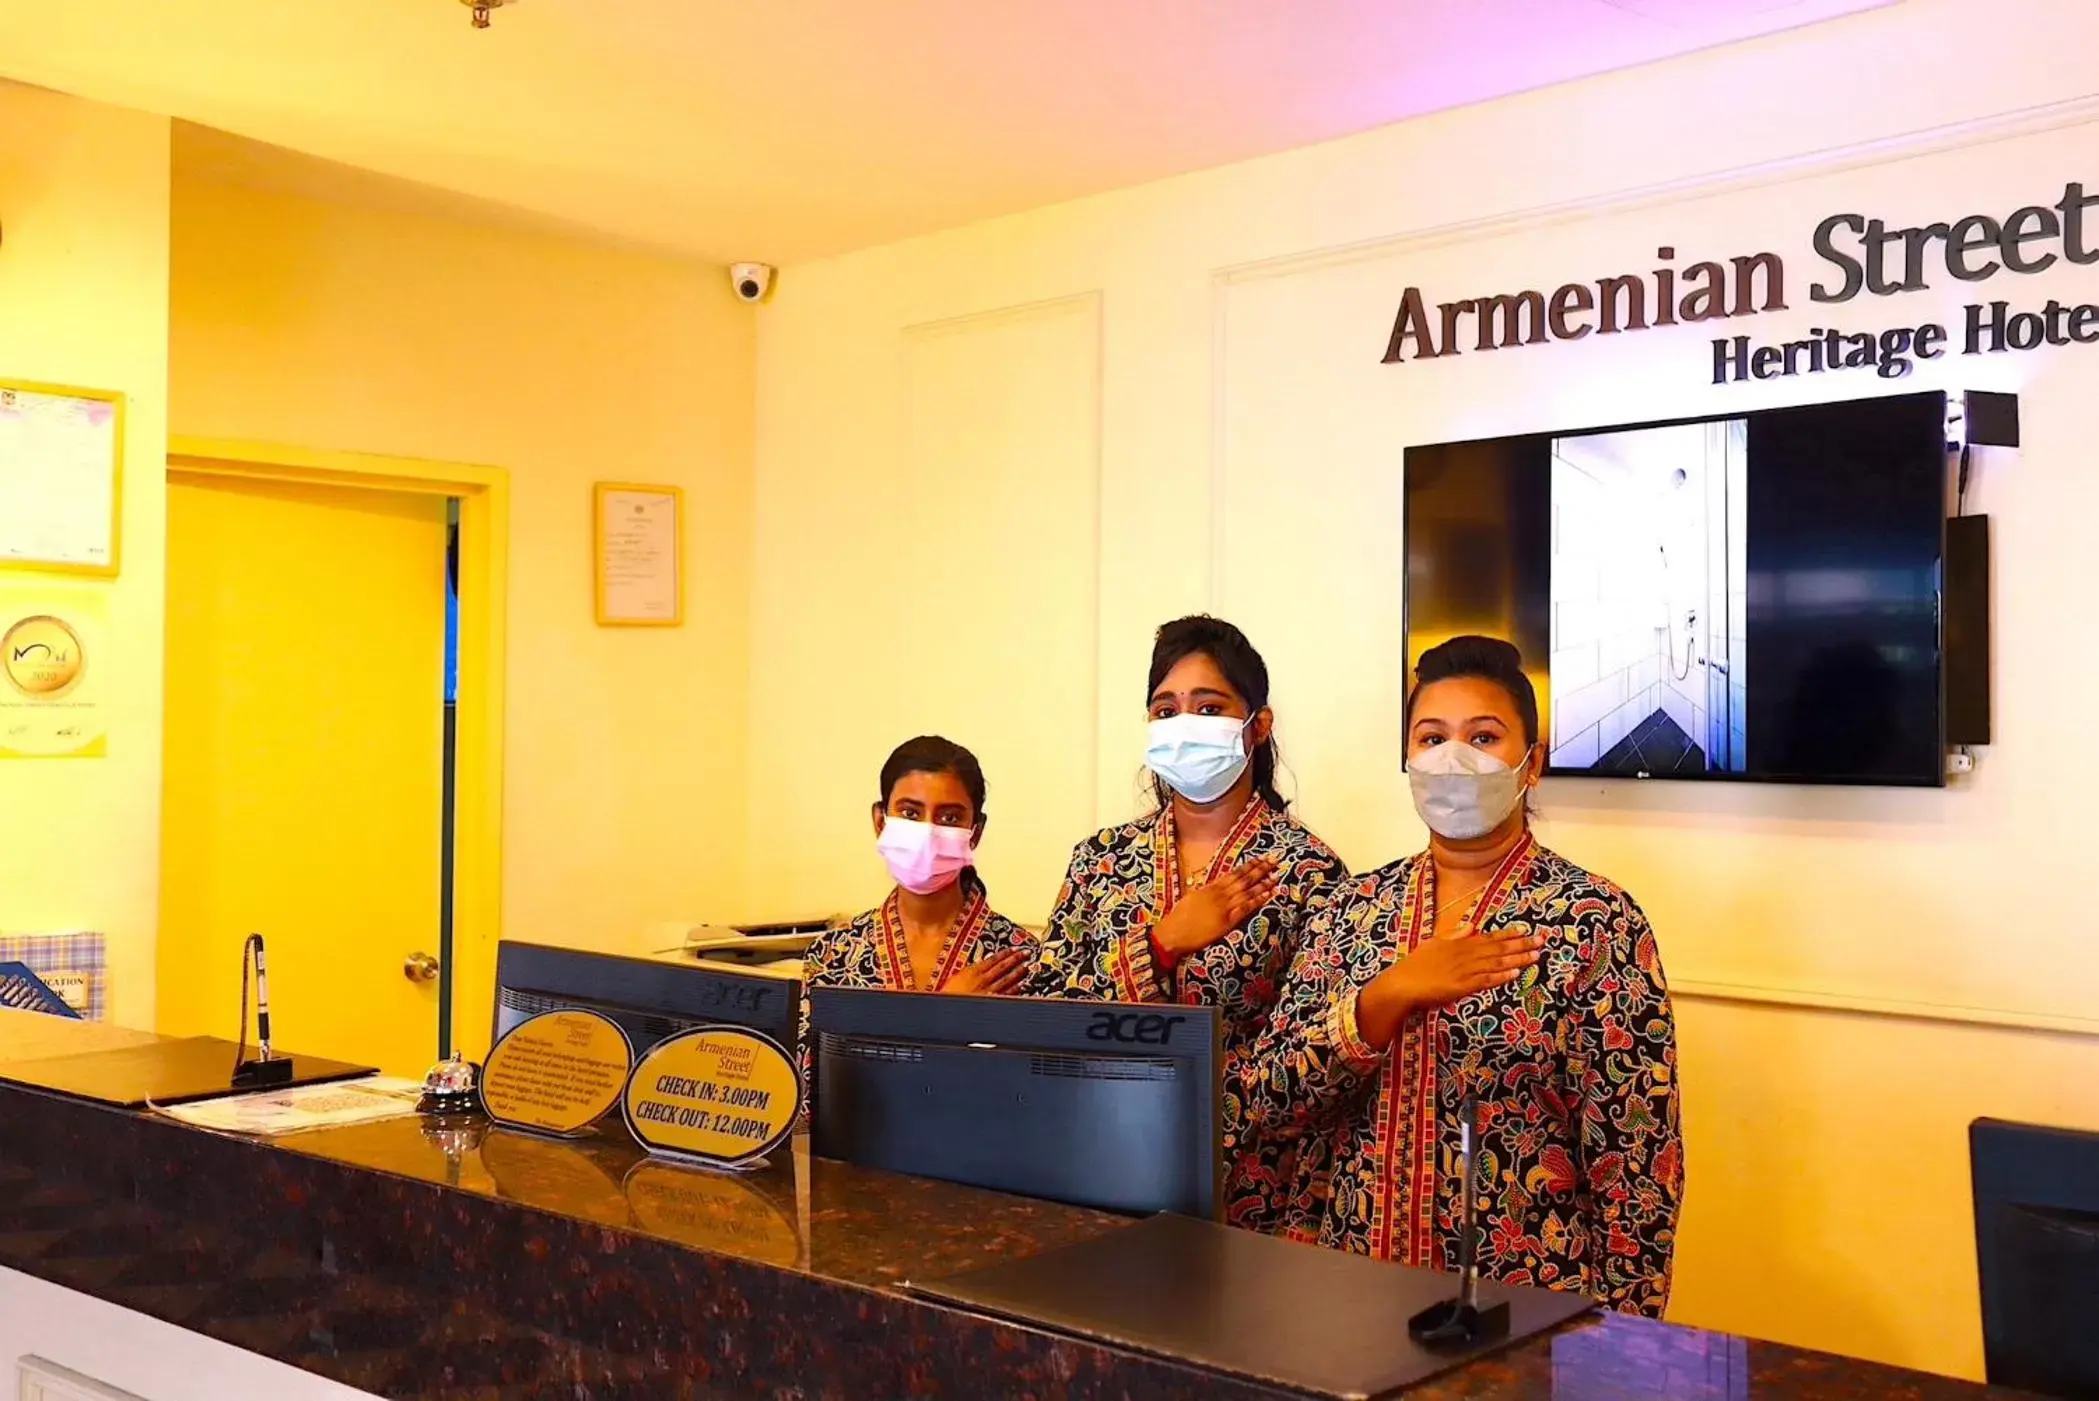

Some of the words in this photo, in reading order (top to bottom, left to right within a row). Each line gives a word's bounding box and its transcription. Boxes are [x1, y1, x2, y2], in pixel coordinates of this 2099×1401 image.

[1381, 246, 1789, 363] Armenian
[1810, 182, 2099, 302] Street
[1711, 323, 1947, 384] Heritage
[1086, 1011, 1185, 1045] acer
[695, 1037, 752, 1059] Armenian
[717, 1056, 751, 1073] Street
[656, 1074, 700, 1098] CHECK
[700, 1080, 719, 1101] IN:
[719, 1086, 771, 1110] 3.00PM
[636, 1100, 679, 1124] CHECK
[679, 1108, 710, 1130] OUT:
[711, 1114, 772, 1141] 12.00PM
